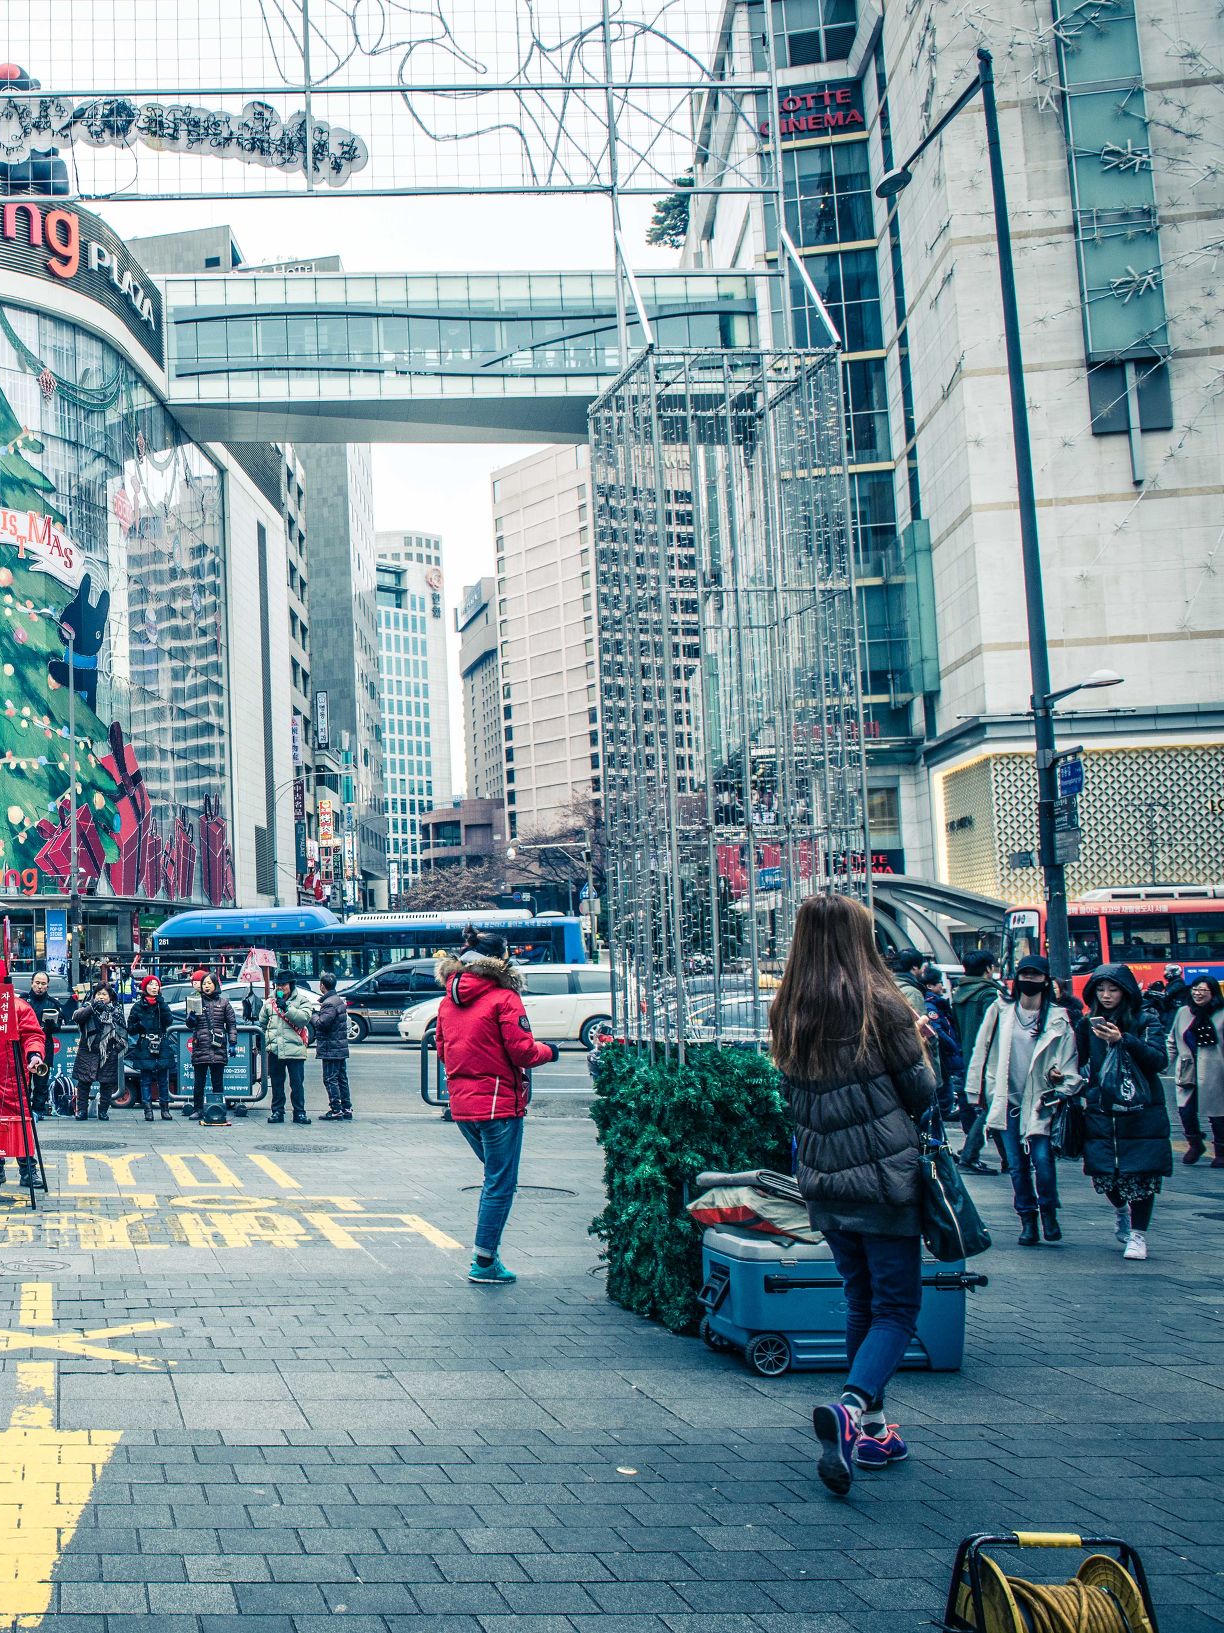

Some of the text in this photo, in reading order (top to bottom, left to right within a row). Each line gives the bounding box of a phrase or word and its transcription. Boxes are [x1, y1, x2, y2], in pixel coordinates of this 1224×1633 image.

[780, 89, 852, 112] OTTE
[88, 241, 155, 331] PLAZA
[0, 991, 10, 1034] 자선냄비
